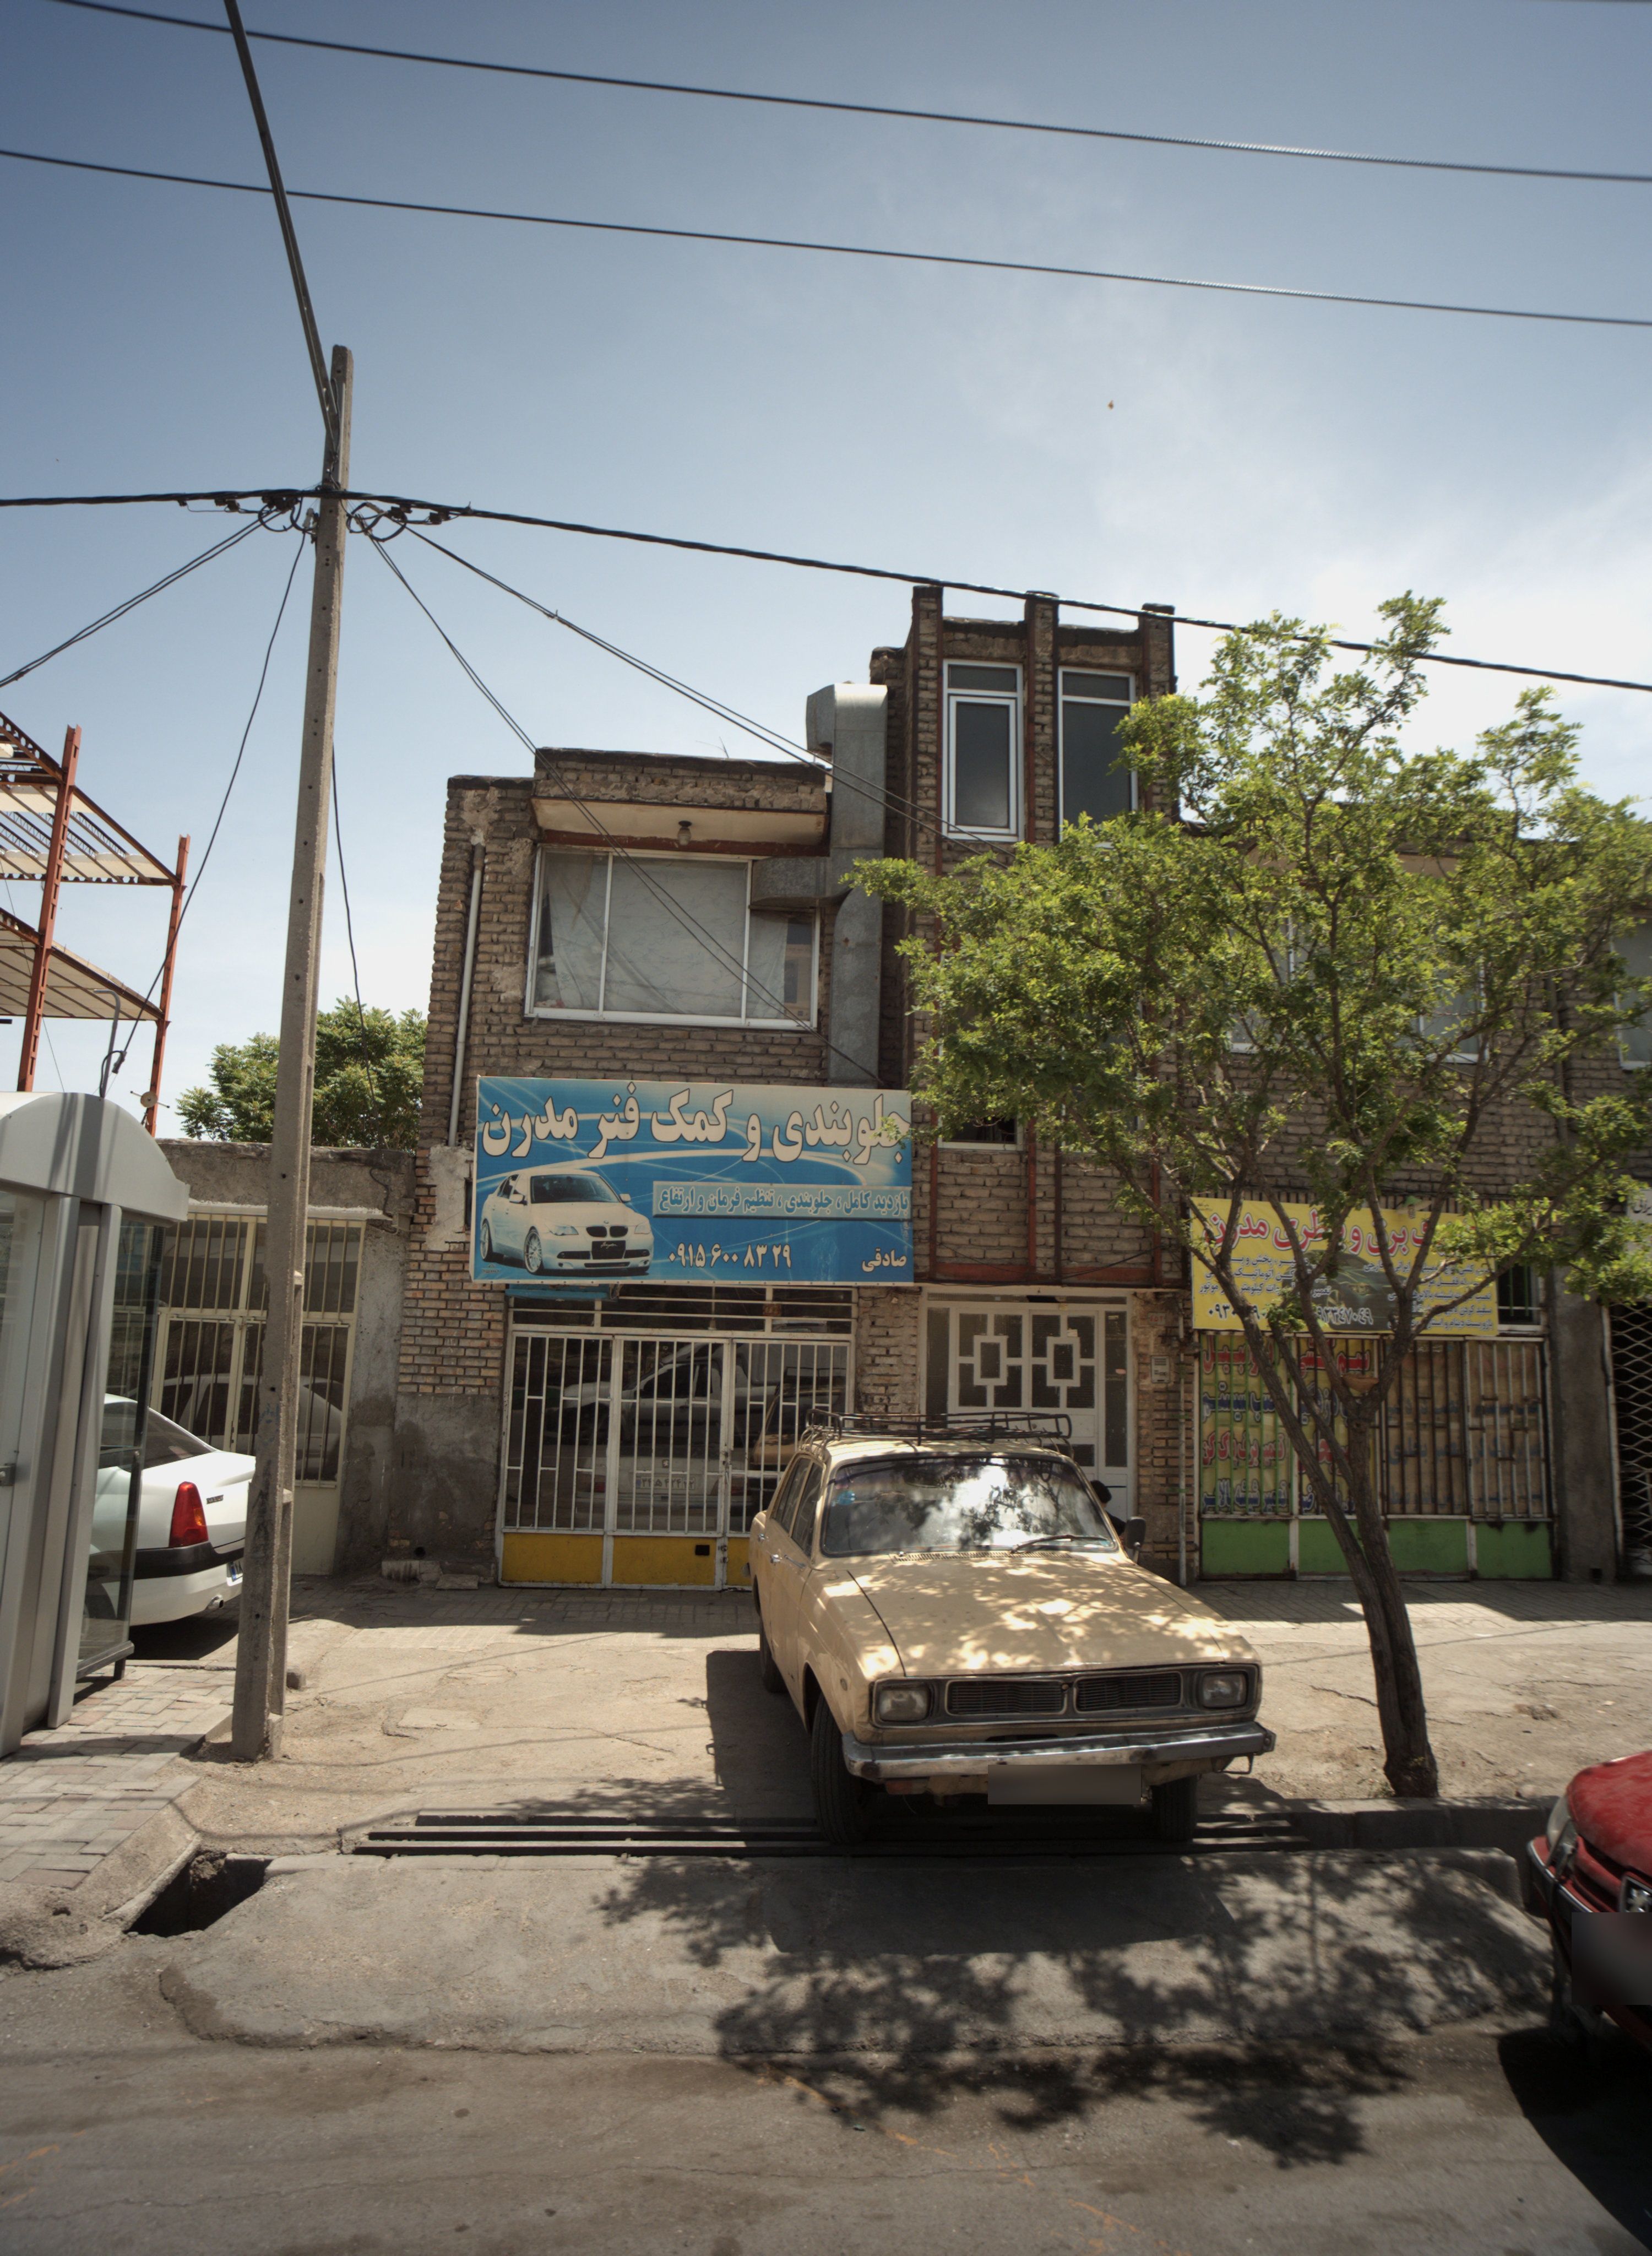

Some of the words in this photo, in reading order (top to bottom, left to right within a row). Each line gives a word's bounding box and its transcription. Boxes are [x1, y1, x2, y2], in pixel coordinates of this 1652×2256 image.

[482, 1096, 579, 1157] مدرن
[588, 1081, 640, 1159] فنر
[651, 1088, 734, 1143] کمک
[772, 1093, 910, 1164] جلوبندی
[742, 1113, 762, 1162] و
[659, 1186, 695, 1212] ارتفاع
[697, 1195, 704, 1212] و
[707, 1186, 741, 1213] فرمان
[743, 1187, 774, 1213] تنظیم
[874, 1191, 909, 1216] بازدید
[861, 1247, 907, 1273] صادقی
